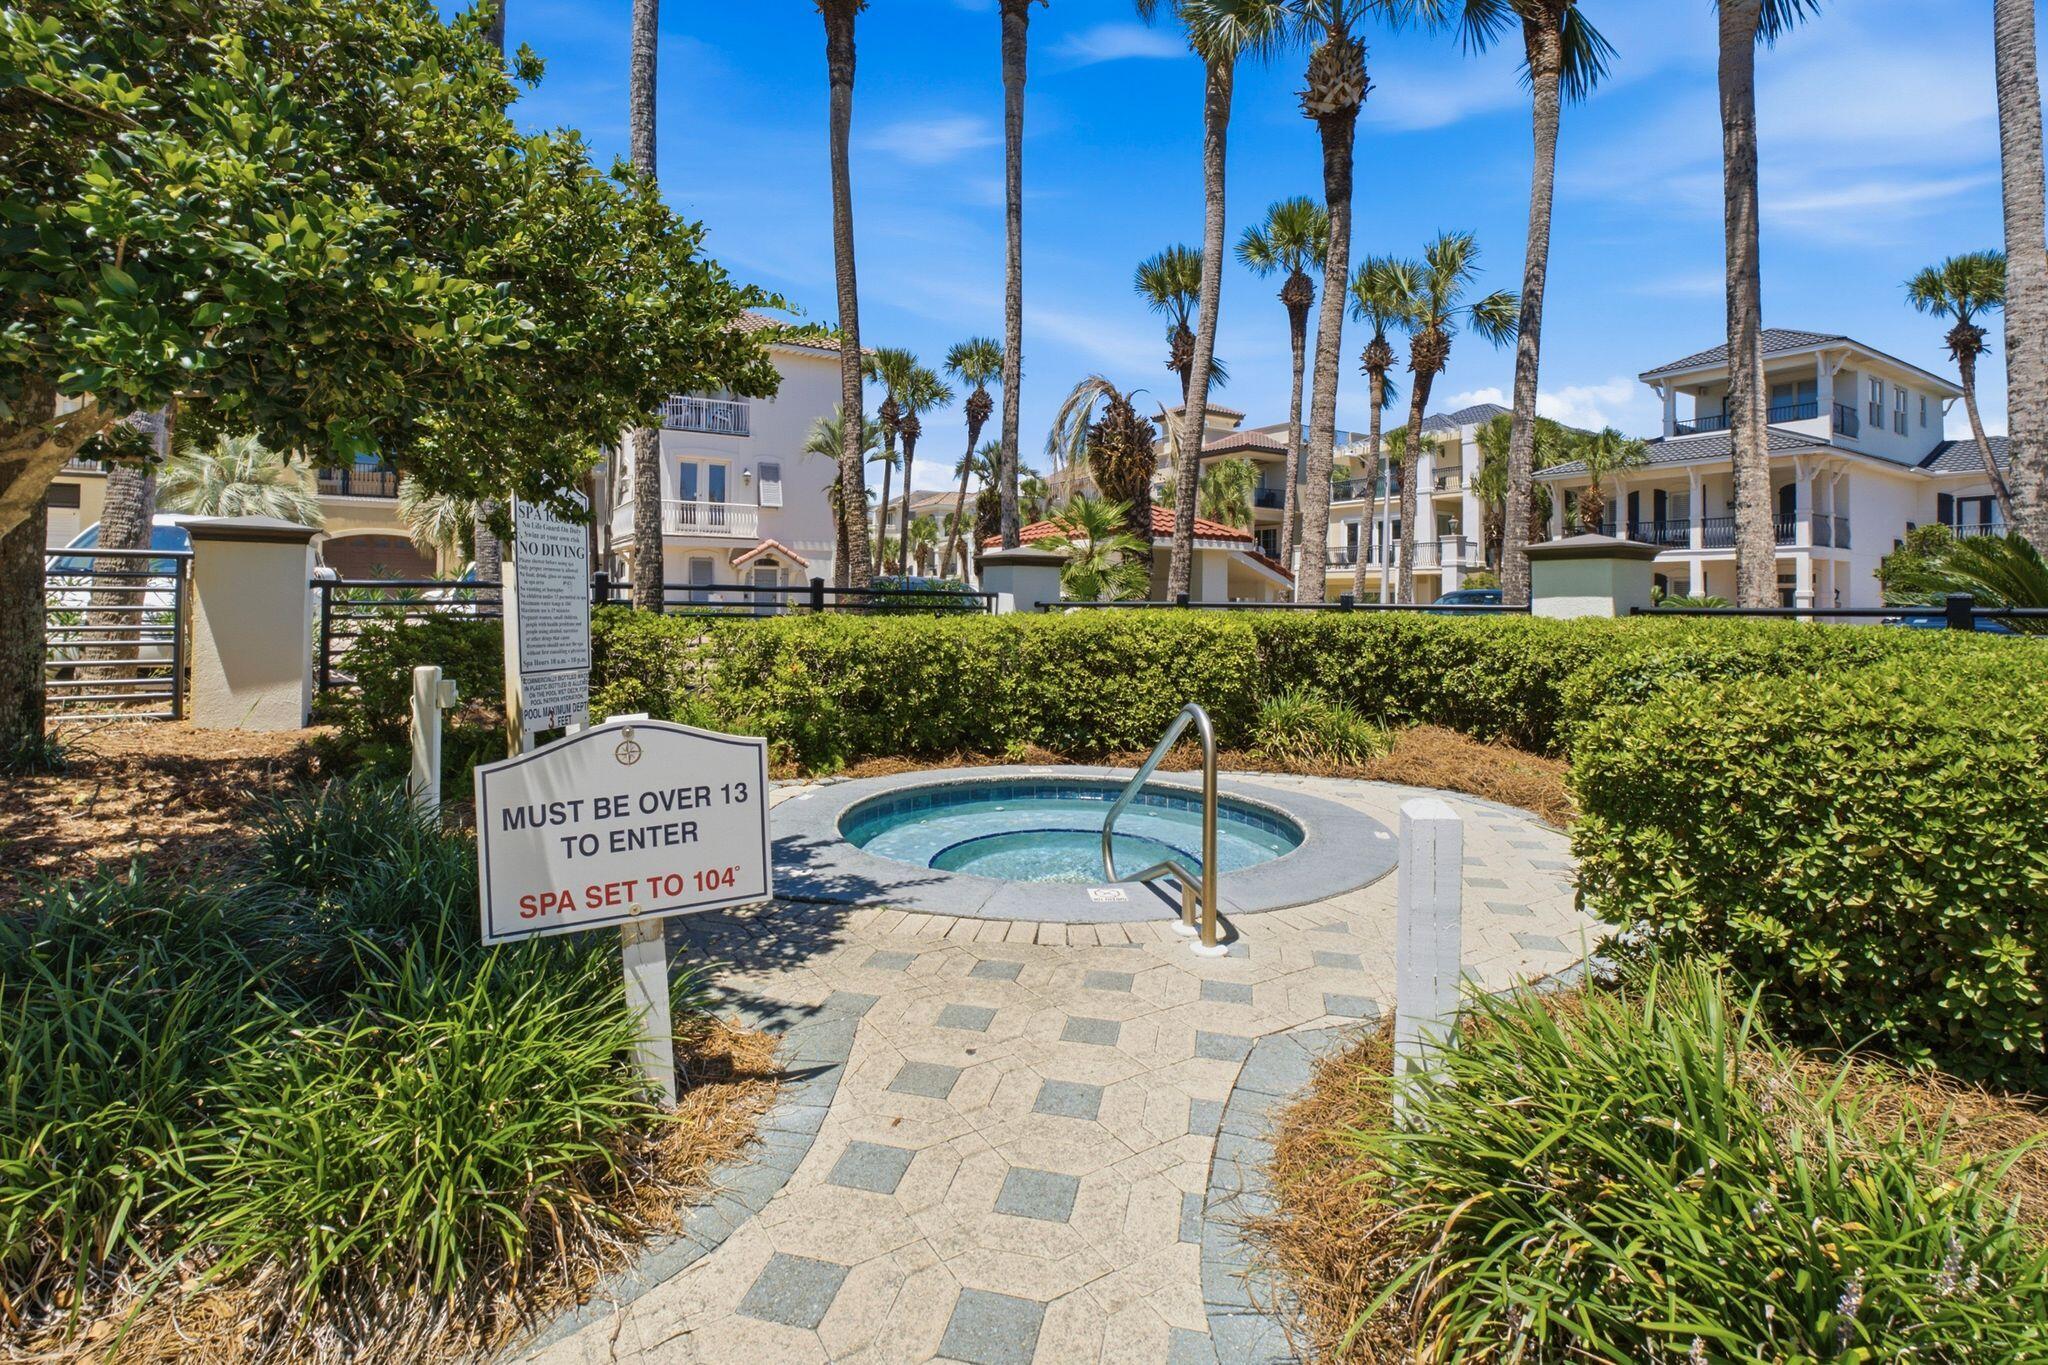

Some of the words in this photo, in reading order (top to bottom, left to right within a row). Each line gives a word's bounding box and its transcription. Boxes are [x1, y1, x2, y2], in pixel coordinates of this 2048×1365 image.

[519, 505, 541, 520] SPA
[520, 541, 538, 555] NO
[542, 544, 584, 559] DIVING
[524, 709, 541, 720] POOL
[543, 703, 571, 718] MAXIMUM
[558, 715, 571, 726] FEET
[502, 800, 584, 831] MUST
[594, 795, 630, 820] BE
[639, 786, 711, 814] OVER
[720, 782, 748, 803] 13
[561, 833, 599, 859] TO
[610, 821, 698, 852] ENTER
[519, 890, 576, 919] SPA
[585, 880, 639, 908] SET
[646, 873, 684, 899] TO
